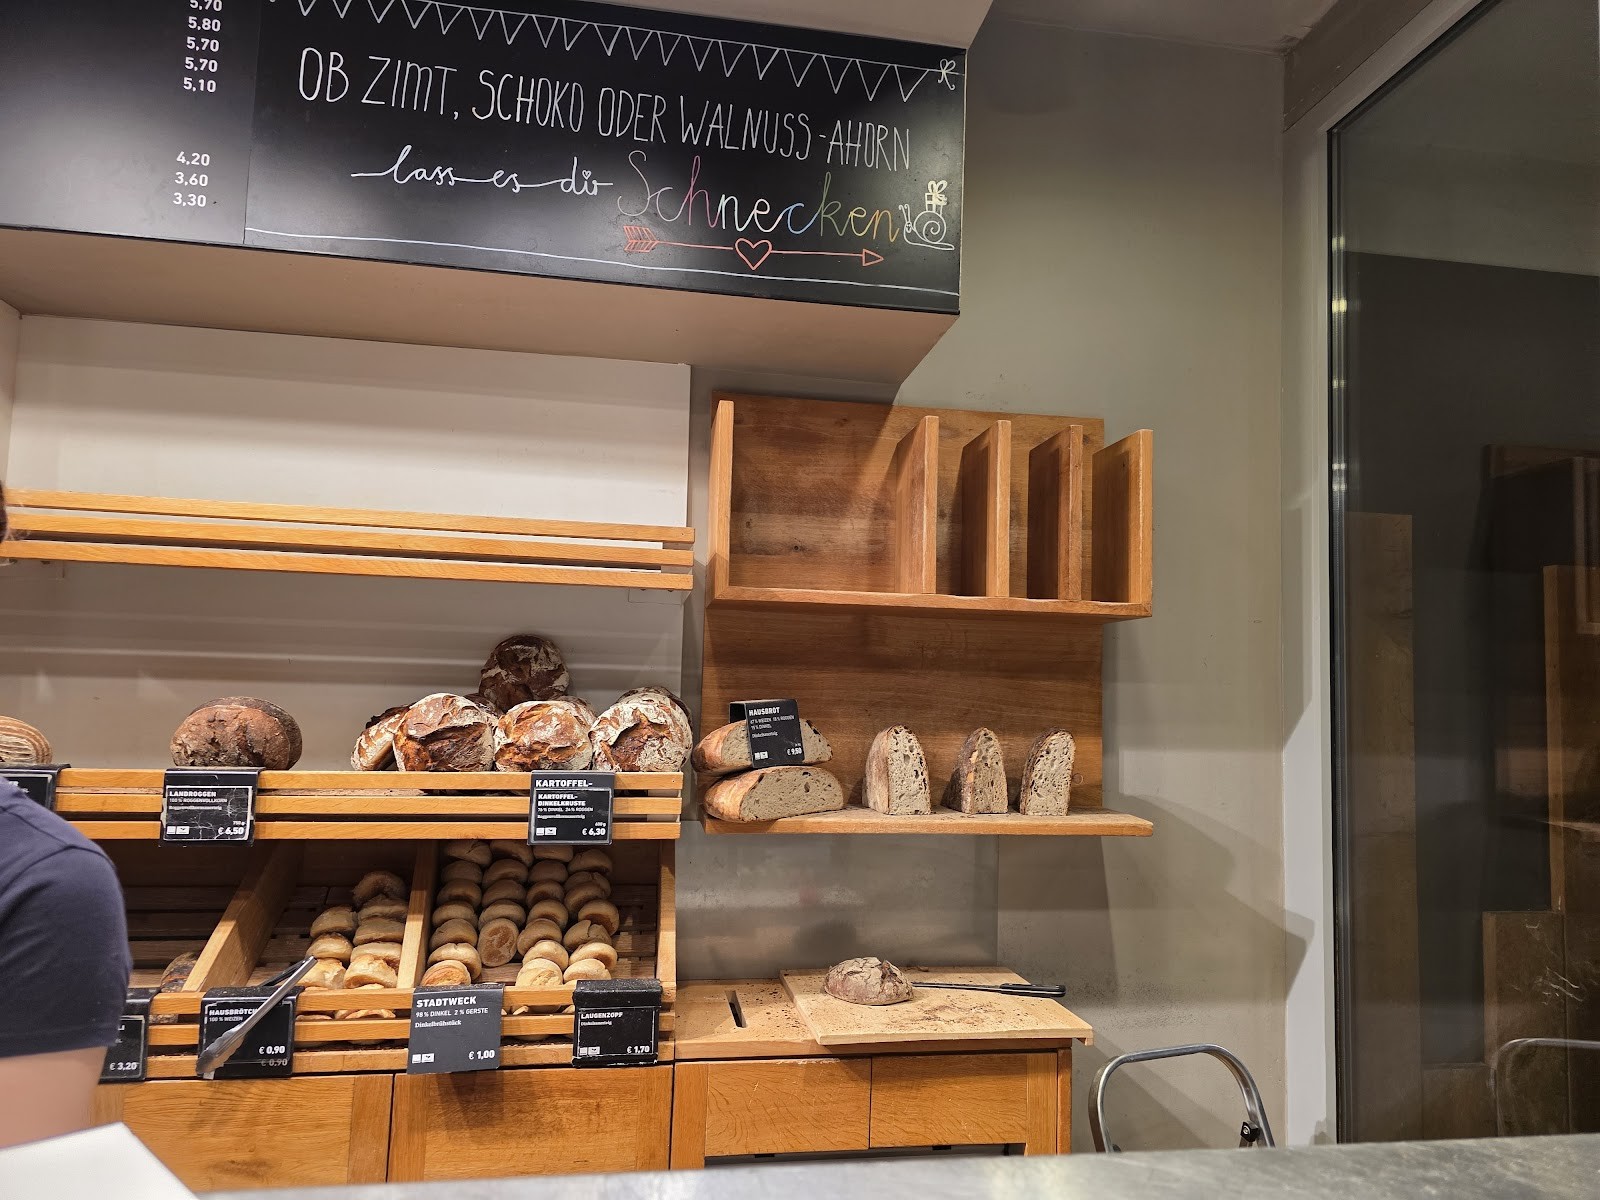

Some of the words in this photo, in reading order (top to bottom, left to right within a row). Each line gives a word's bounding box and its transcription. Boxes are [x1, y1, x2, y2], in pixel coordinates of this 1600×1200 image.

[189, 0, 223, 11] 5,70
[187, 16, 221, 32] 5,80
[186, 36, 220, 52] 5,70
[184, 57, 218, 72] 5,70
[183, 77, 217, 92] 5,10
[299, 47, 349, 102] OB
[472, 69, 584, 132] SCHOKO
[598, 87, 666, 143] ODER
[176, 151, 210, 166] 4,20
[174, 171, 209, 187] 3,60
[172, 192, 207, 207] 3,30
[351, 145, 458, 186] lass
[558, 156, 613, 195] dir
[617, 150, 900, 242] Schnecken
[748, 706, 780, 716] HAUSBROT
[225, 827, 245, 835] 6,50
[582, 828, 587, 836] €
[588, 828, 606, 836] 6,30
[416, 996, 477, 1008] STADTWECK
[466, 1007, 489, 1015] GERSTE
[259, 1046, 265, 1055] €
[266, 1045, 286, 1055] 0,90
[468, 1052, 475, 1060] €
[476, 1050, 496, 1060] 1,00
[633, 1045, 650, 1053] 1,70
[110, 1062, 116, 1070] €
[117, 1062, 138, 1070] 3,20
